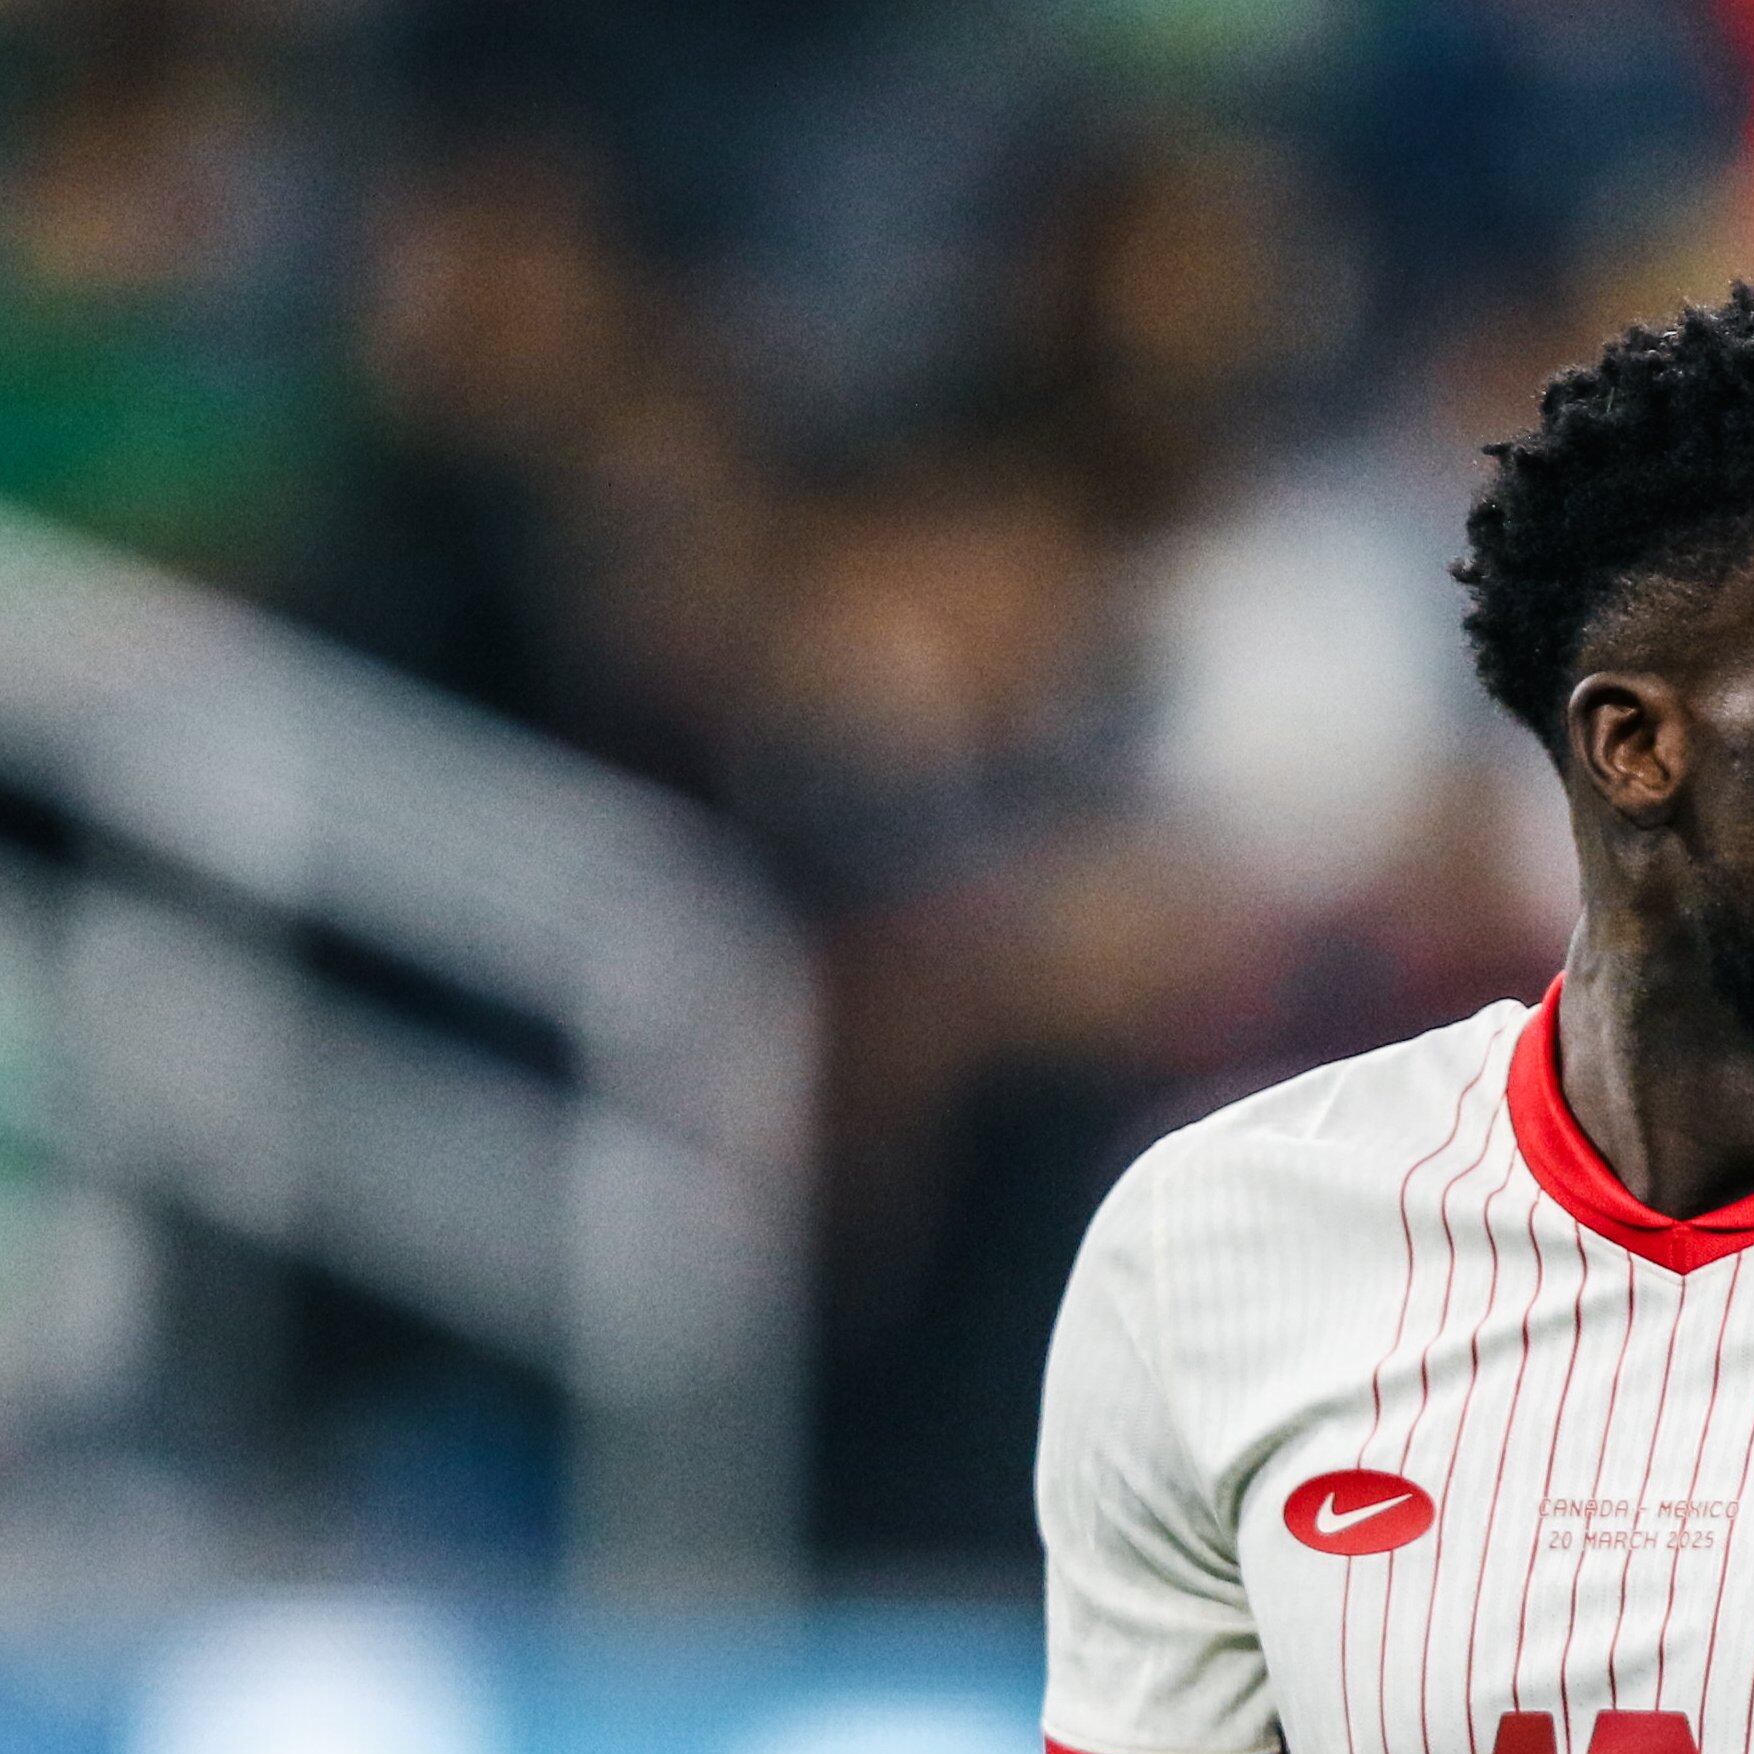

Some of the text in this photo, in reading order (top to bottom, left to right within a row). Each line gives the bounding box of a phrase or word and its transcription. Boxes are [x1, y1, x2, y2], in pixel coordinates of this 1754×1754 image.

[1538, 1499, 1629, 1518] CANADA
[1657, 1500, 1740, 1519] MEXICO
[1549, 1530, 1715, 1550] 20 MARCH 2025
